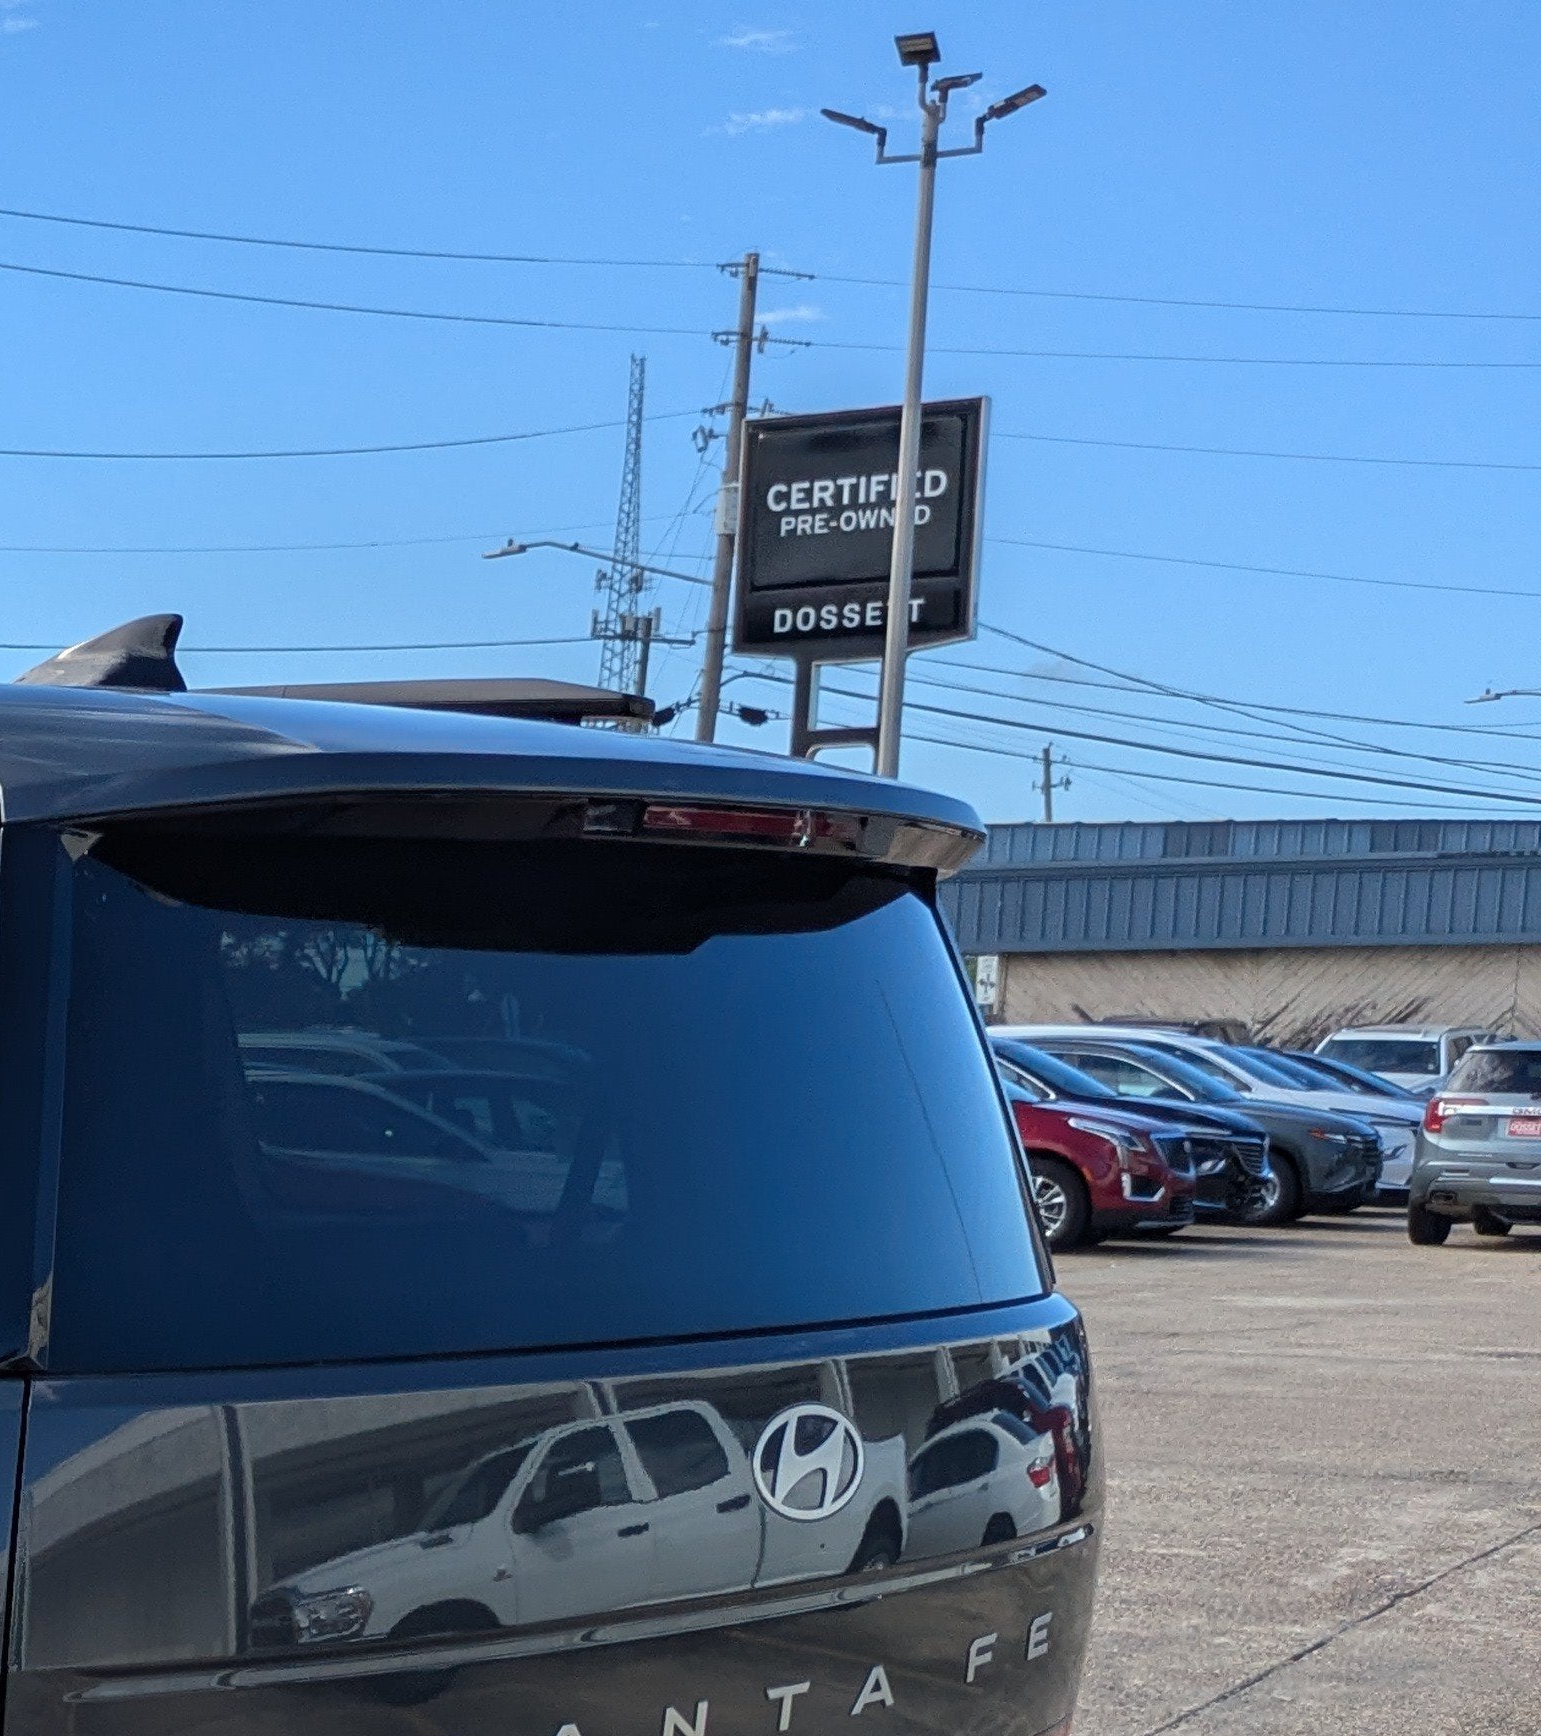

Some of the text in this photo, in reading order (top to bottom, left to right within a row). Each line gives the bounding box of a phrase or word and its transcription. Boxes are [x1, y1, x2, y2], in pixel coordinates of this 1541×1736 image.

[767, 470, 948, 511] CERTIFID
[780, 505, 931, 537] PRE-OWND
[773, 599, 925, 633] DOSSET
[966, 1612, 1053, 1682] FE
